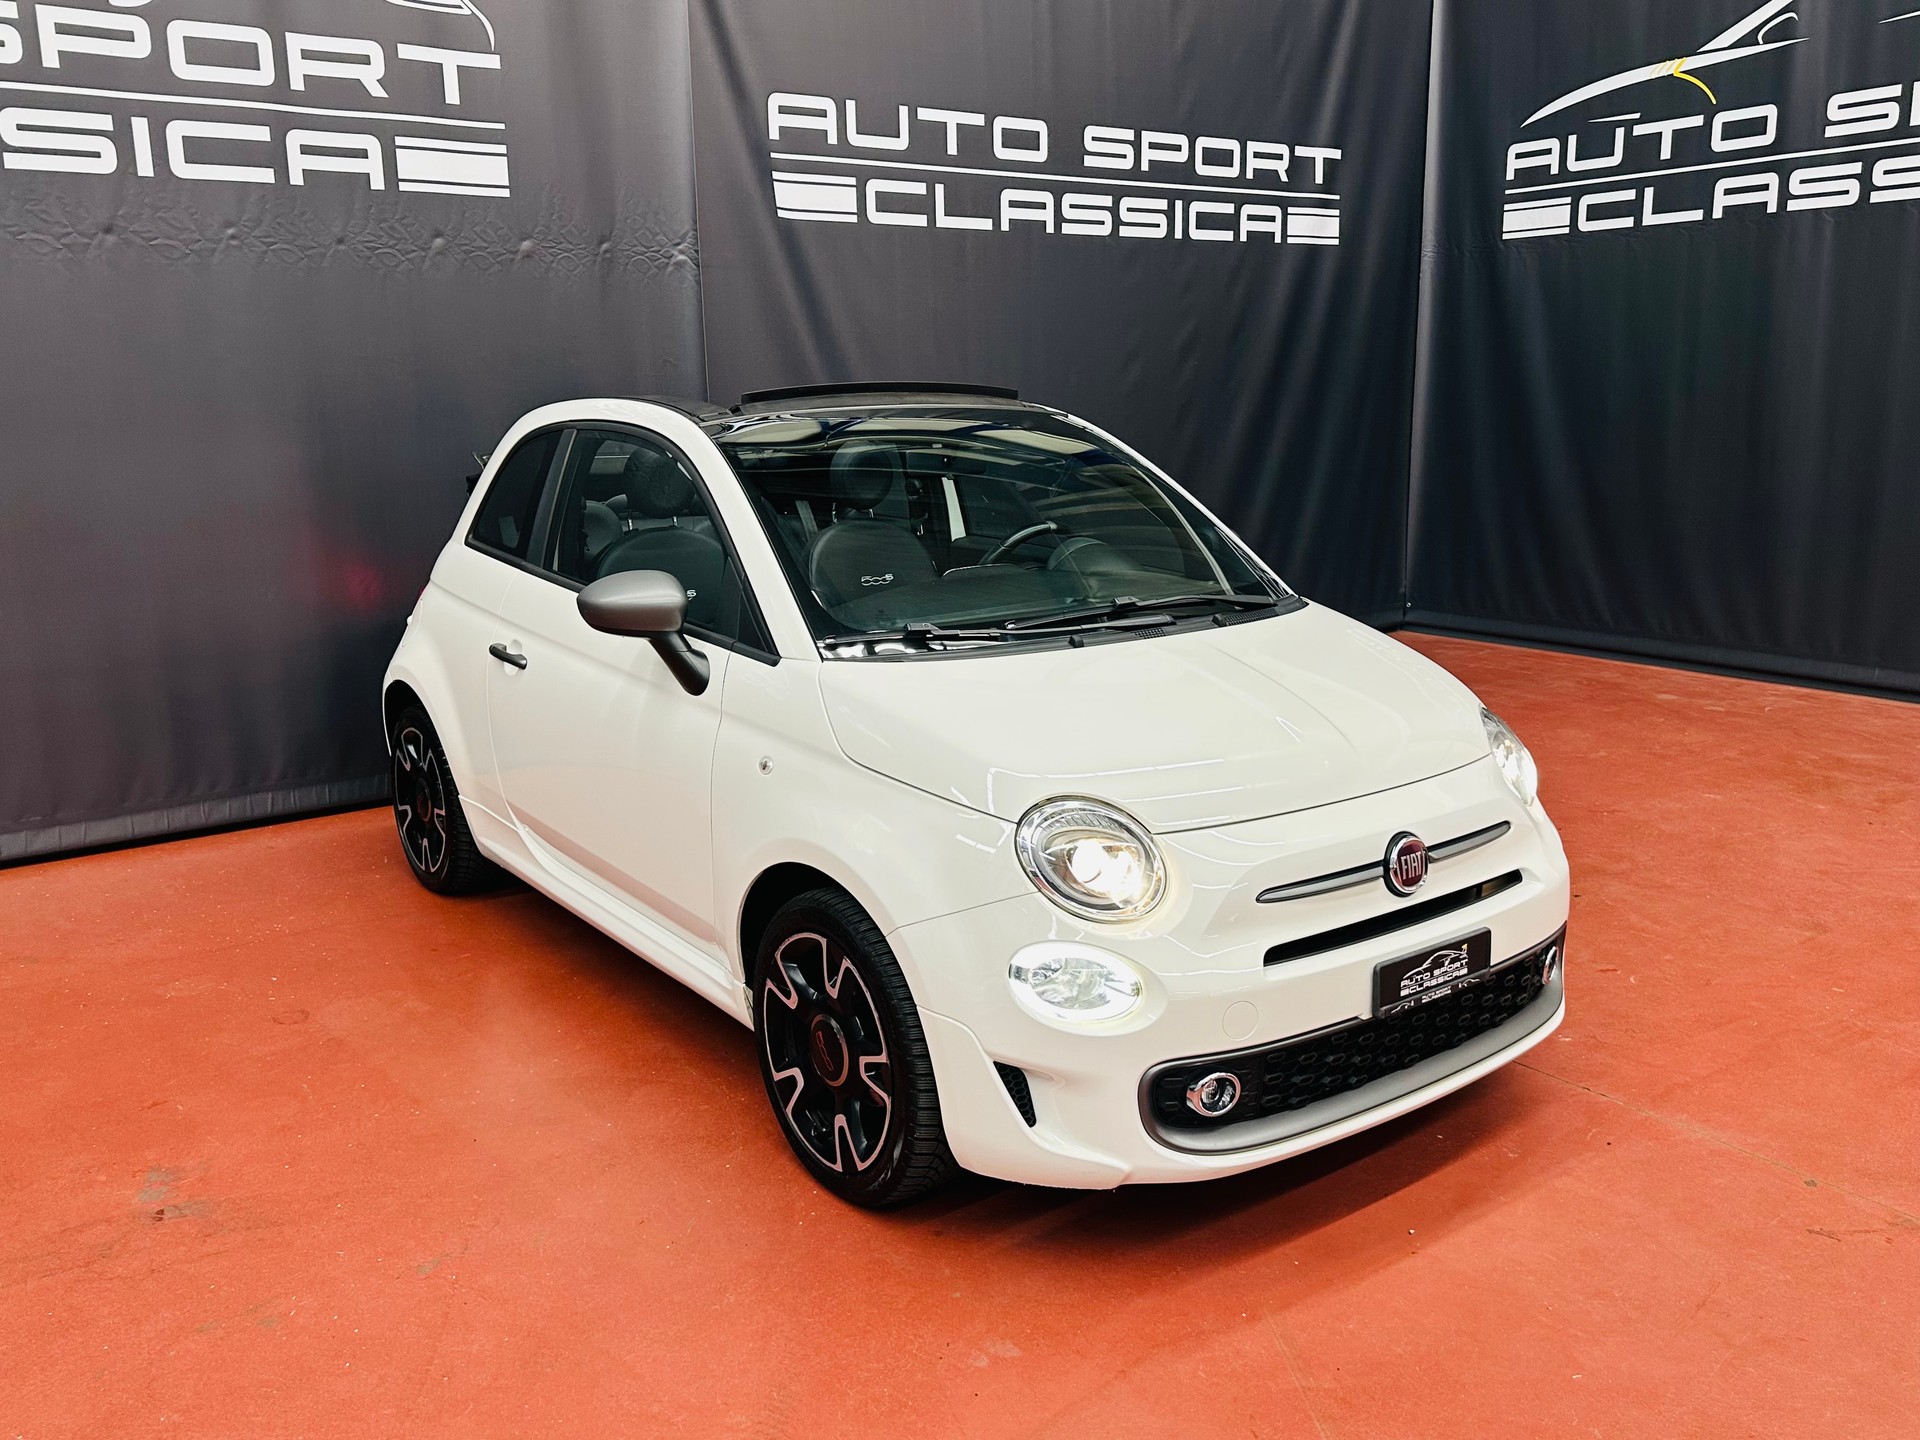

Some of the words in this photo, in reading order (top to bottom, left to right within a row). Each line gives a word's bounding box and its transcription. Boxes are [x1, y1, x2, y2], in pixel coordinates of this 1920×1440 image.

[0, 0, 501, 105] PORT
[0, 107, 386, 190] SICA
[767, 92, 1048, 163] AUTO
[1083, 125, 1342, 184] SPORT
[1505, 103, 1778, 181] AUTO
[1823, 80, 1920, 138] S
[866, 178, 1283, 243] CLASSICA
[1400, 850, 1422, 880] FIAT
[1401, 972, 1431, 988] AUTO
[1433, 959, 1469, 977] SPORT
[1409, 970, 1460, 994] CLASSICA
